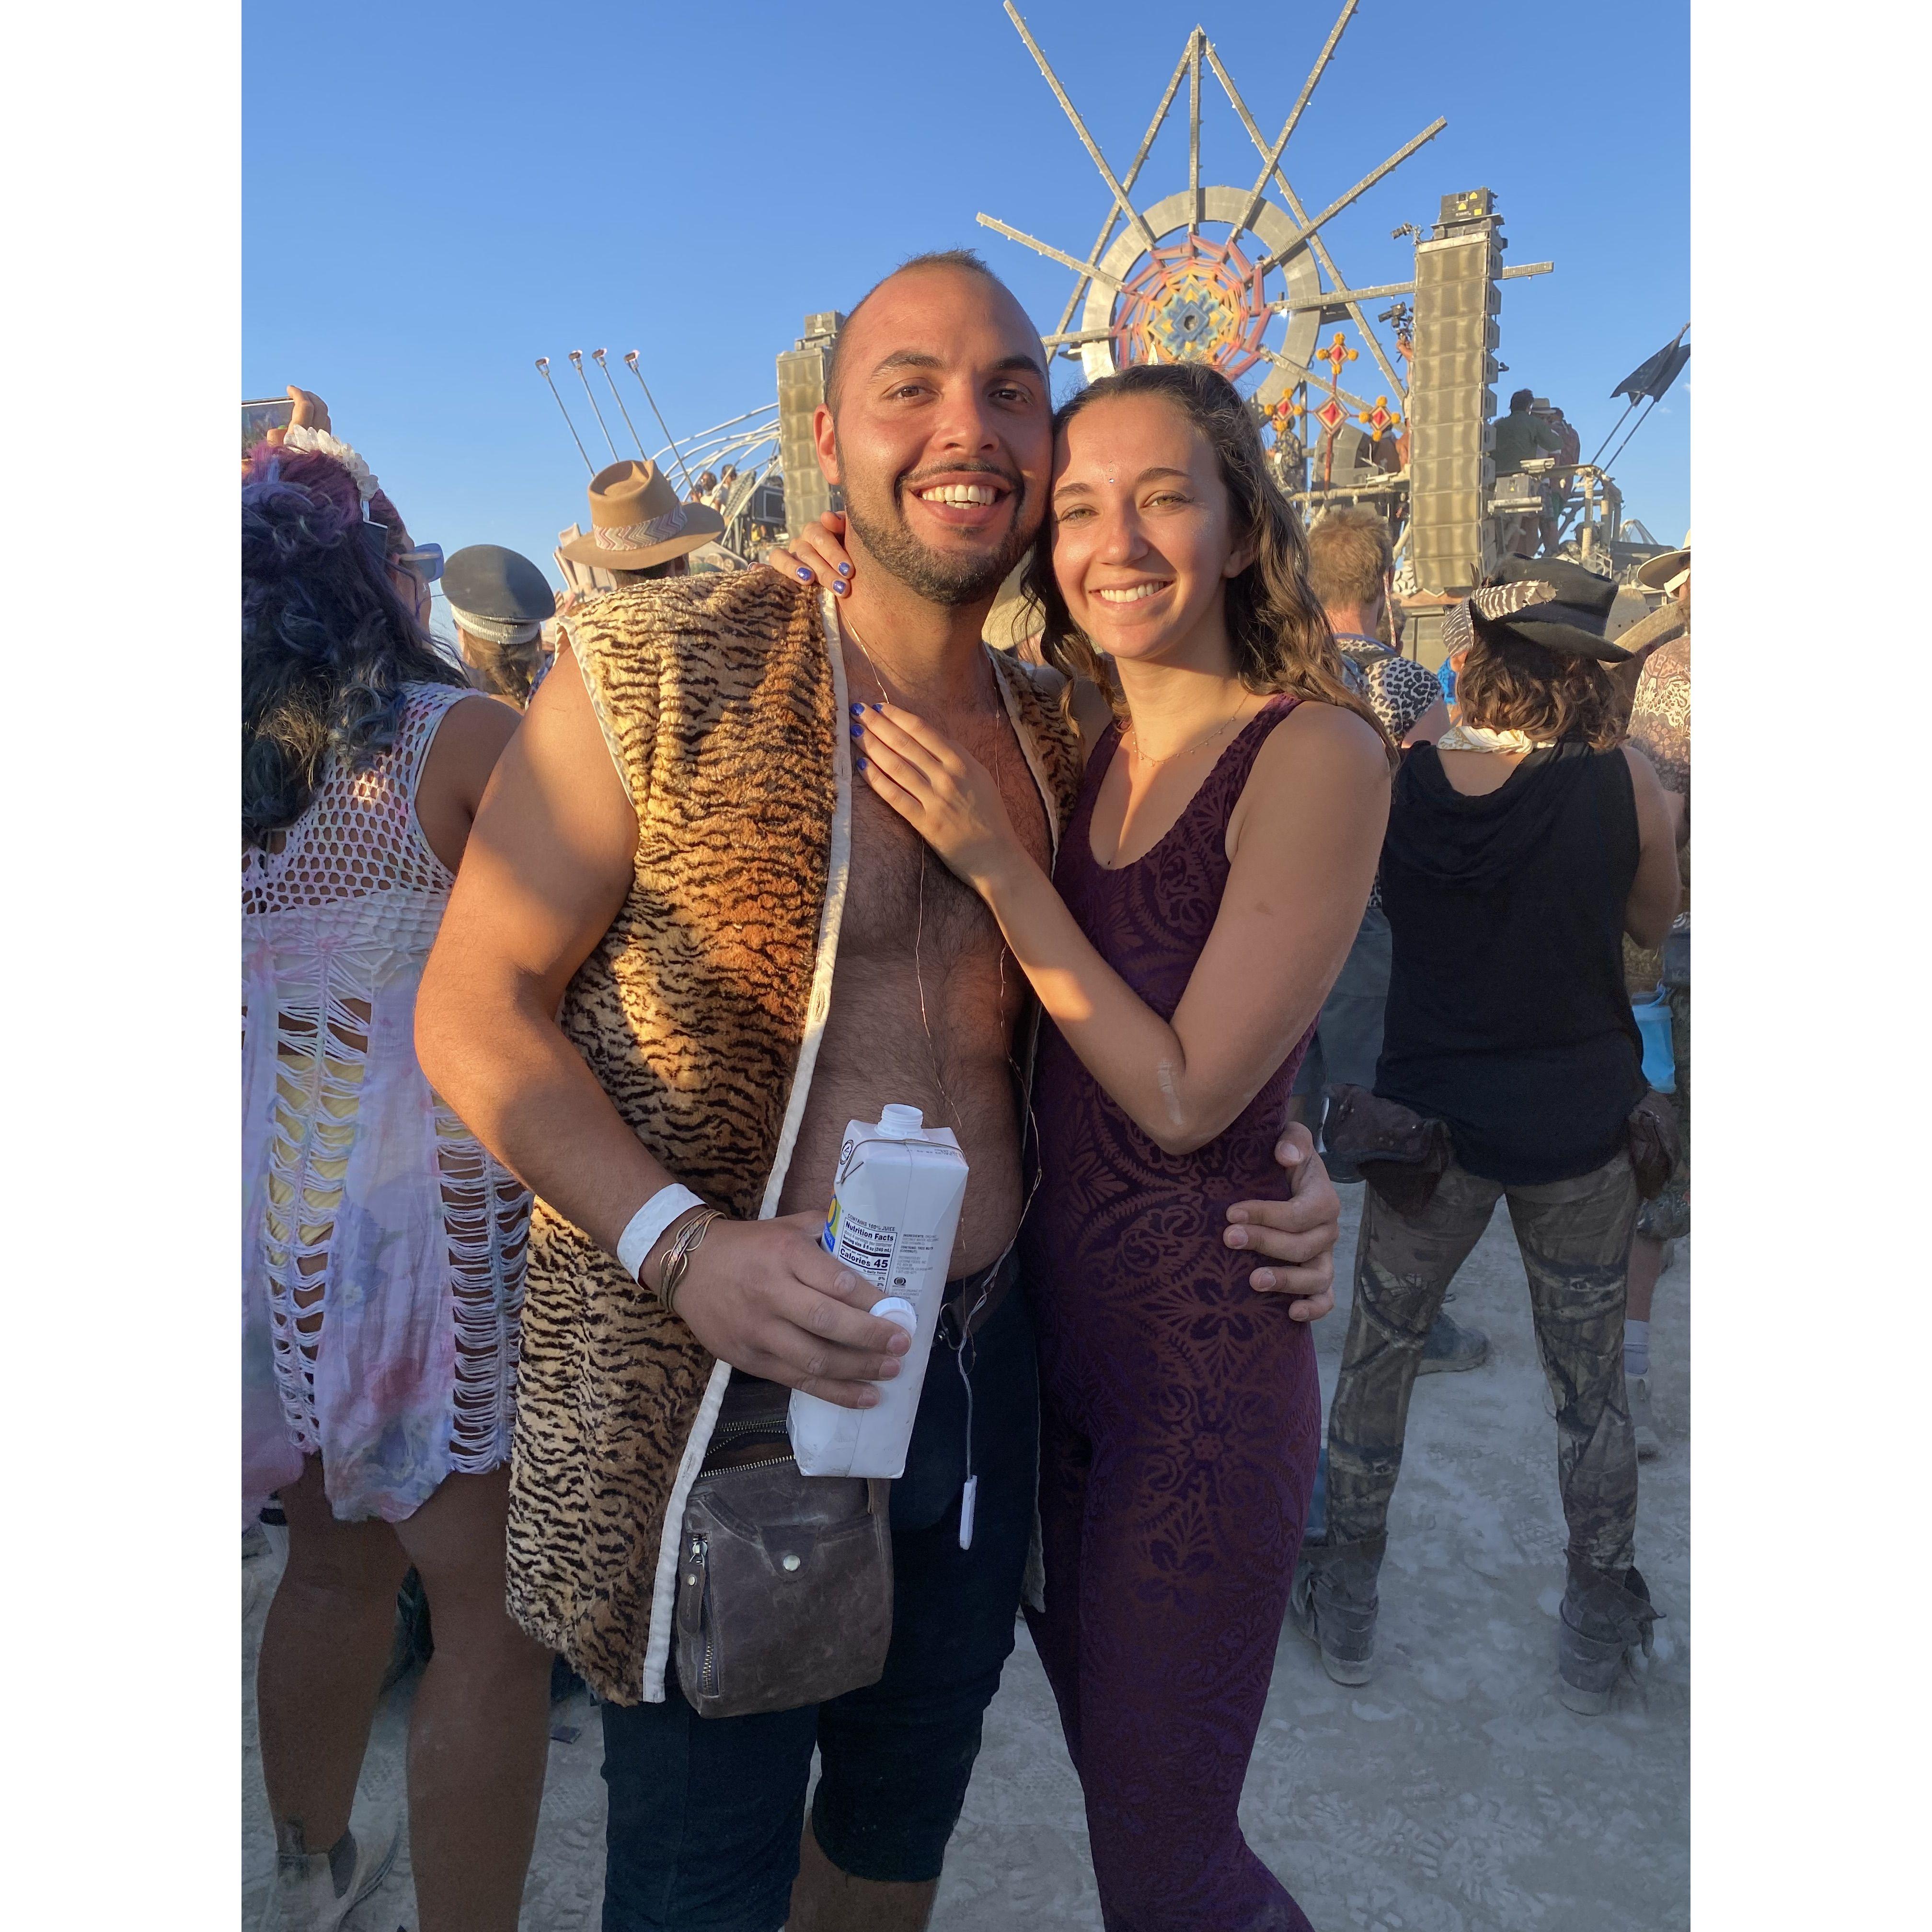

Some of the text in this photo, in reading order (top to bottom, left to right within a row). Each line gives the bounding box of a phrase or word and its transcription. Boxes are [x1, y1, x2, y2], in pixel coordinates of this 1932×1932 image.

[848, 1214, 867, 1226] CONTAINS
[846, 1221, 872, 1238] Nutrition
[840, 1248, 888, 1268] Calories 45
